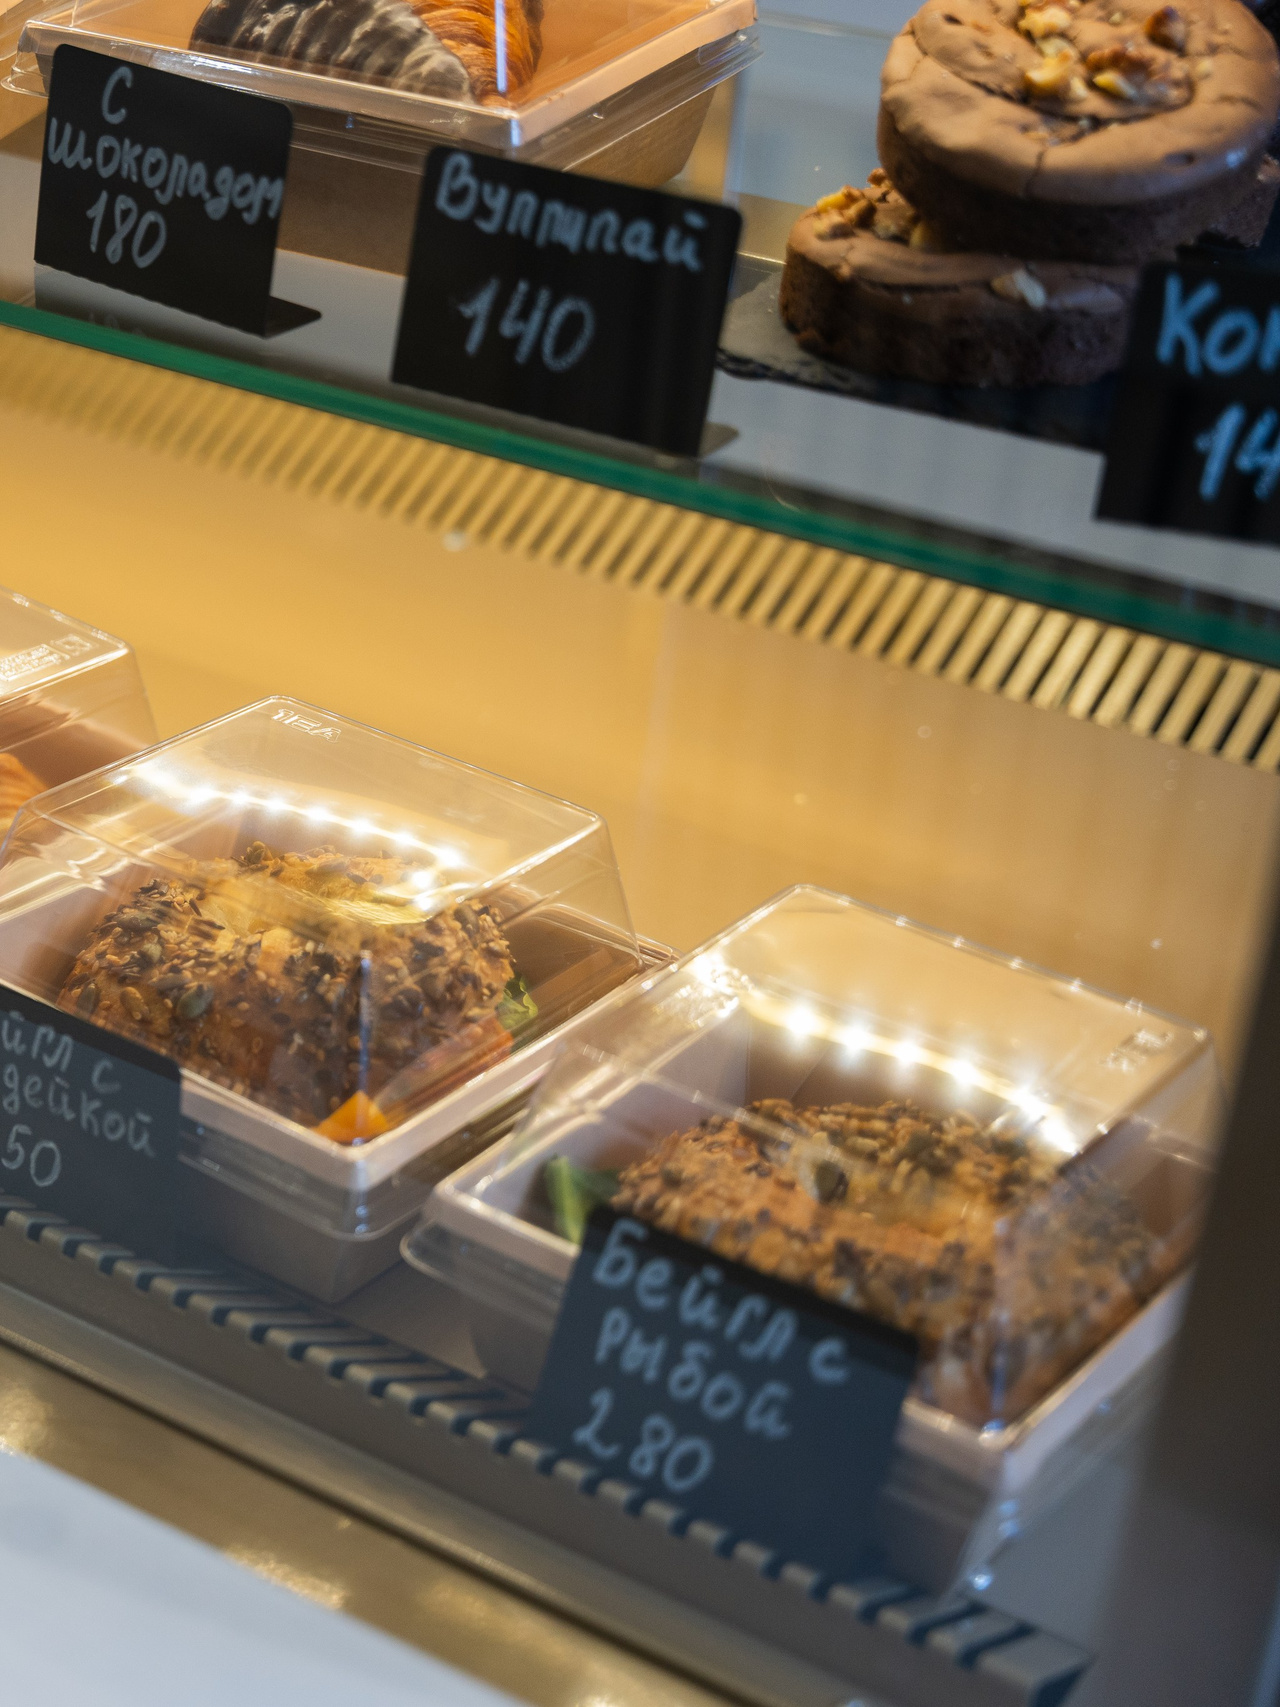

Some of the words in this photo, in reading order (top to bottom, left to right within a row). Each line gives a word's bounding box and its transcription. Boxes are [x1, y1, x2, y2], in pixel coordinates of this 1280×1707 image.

[47, 117, 284, 225] шоколадом
[86, 190, 167, 268] 180
[457, 276, 595, 373] 140
[593, 1217, 798, 1364] Бейгл
[573, 1387, 714, 1491] 280
